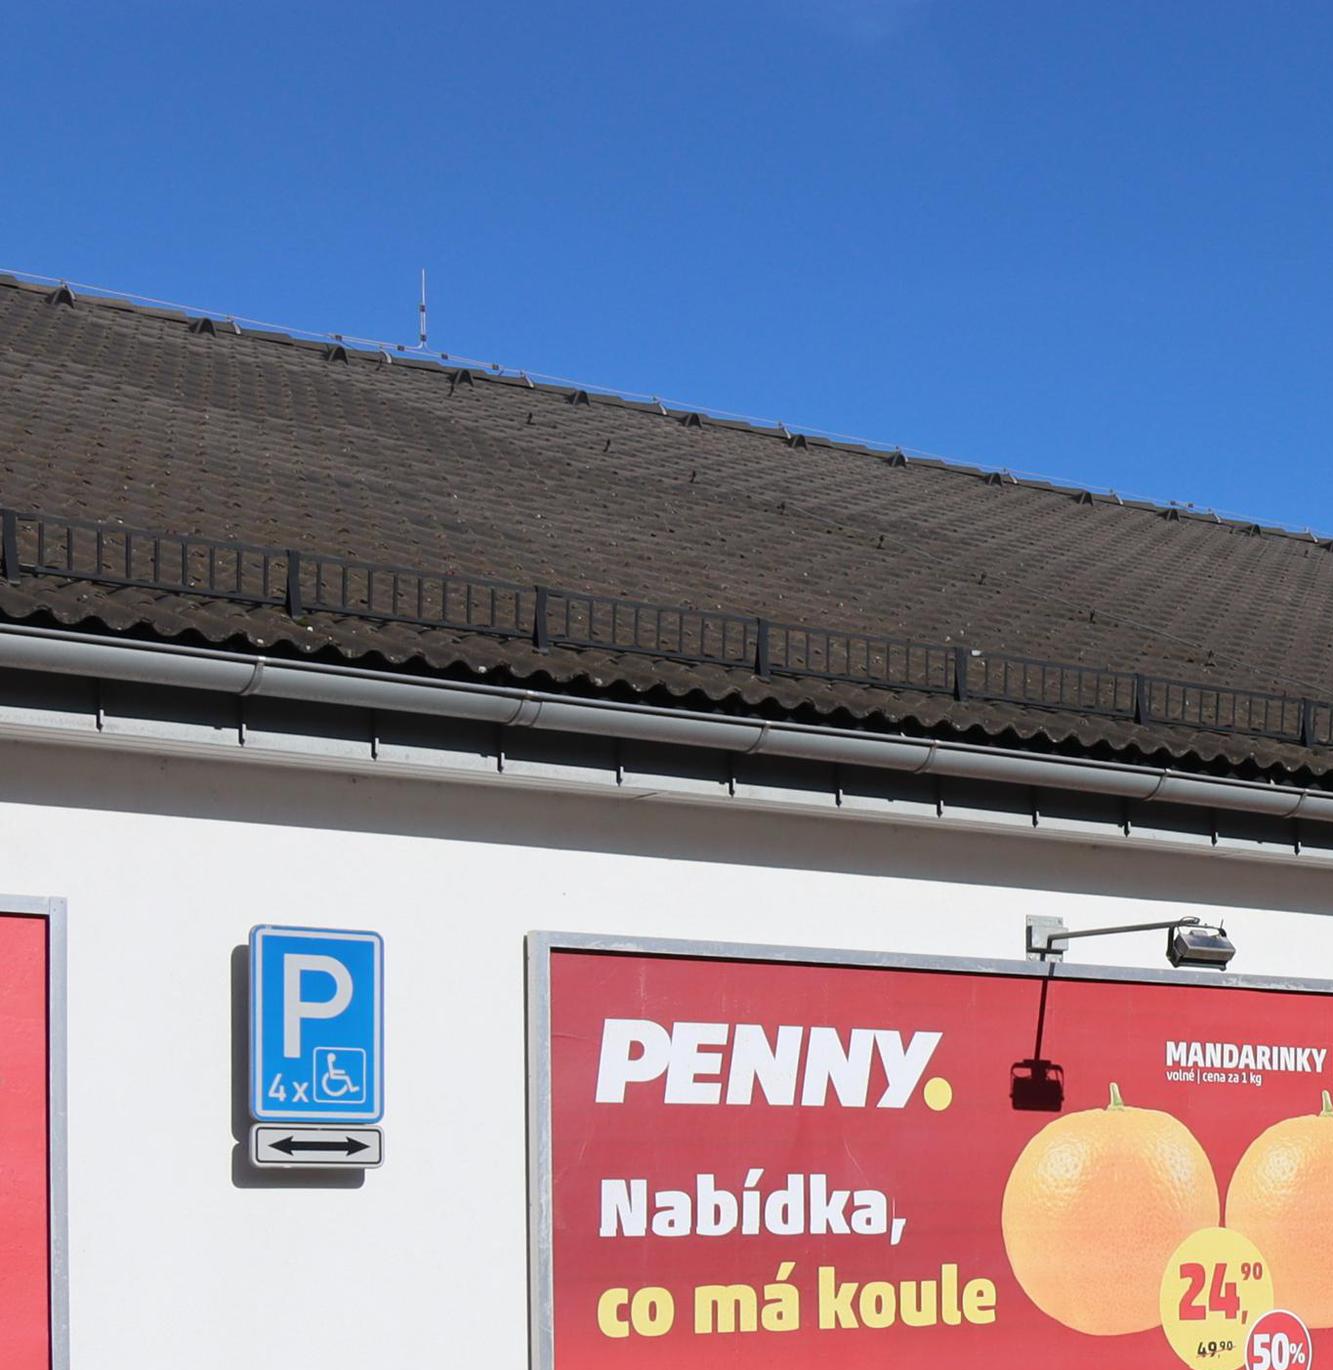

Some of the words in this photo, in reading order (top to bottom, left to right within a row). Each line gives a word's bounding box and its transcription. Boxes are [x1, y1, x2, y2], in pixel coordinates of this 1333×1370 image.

[283, 953, 354, 1059] P
[1166, 1041, 1326, 1073] MANDARINKY
[1167, 1070, 1195, 1082] volné
[1202, 1073, 1226, 1083] cena
[1227, 1074, 1239, 1083] za
[1242, 1072, 1247, 1083] 1
[1250, 1072, 1262, 1086] kg
[600, 1169, 906, 1245] Nabídka,
[597, 1286, 674, 1338] co
[694, 1261, 800, 1334] má
[818, 1263, 996, 1330] koule
